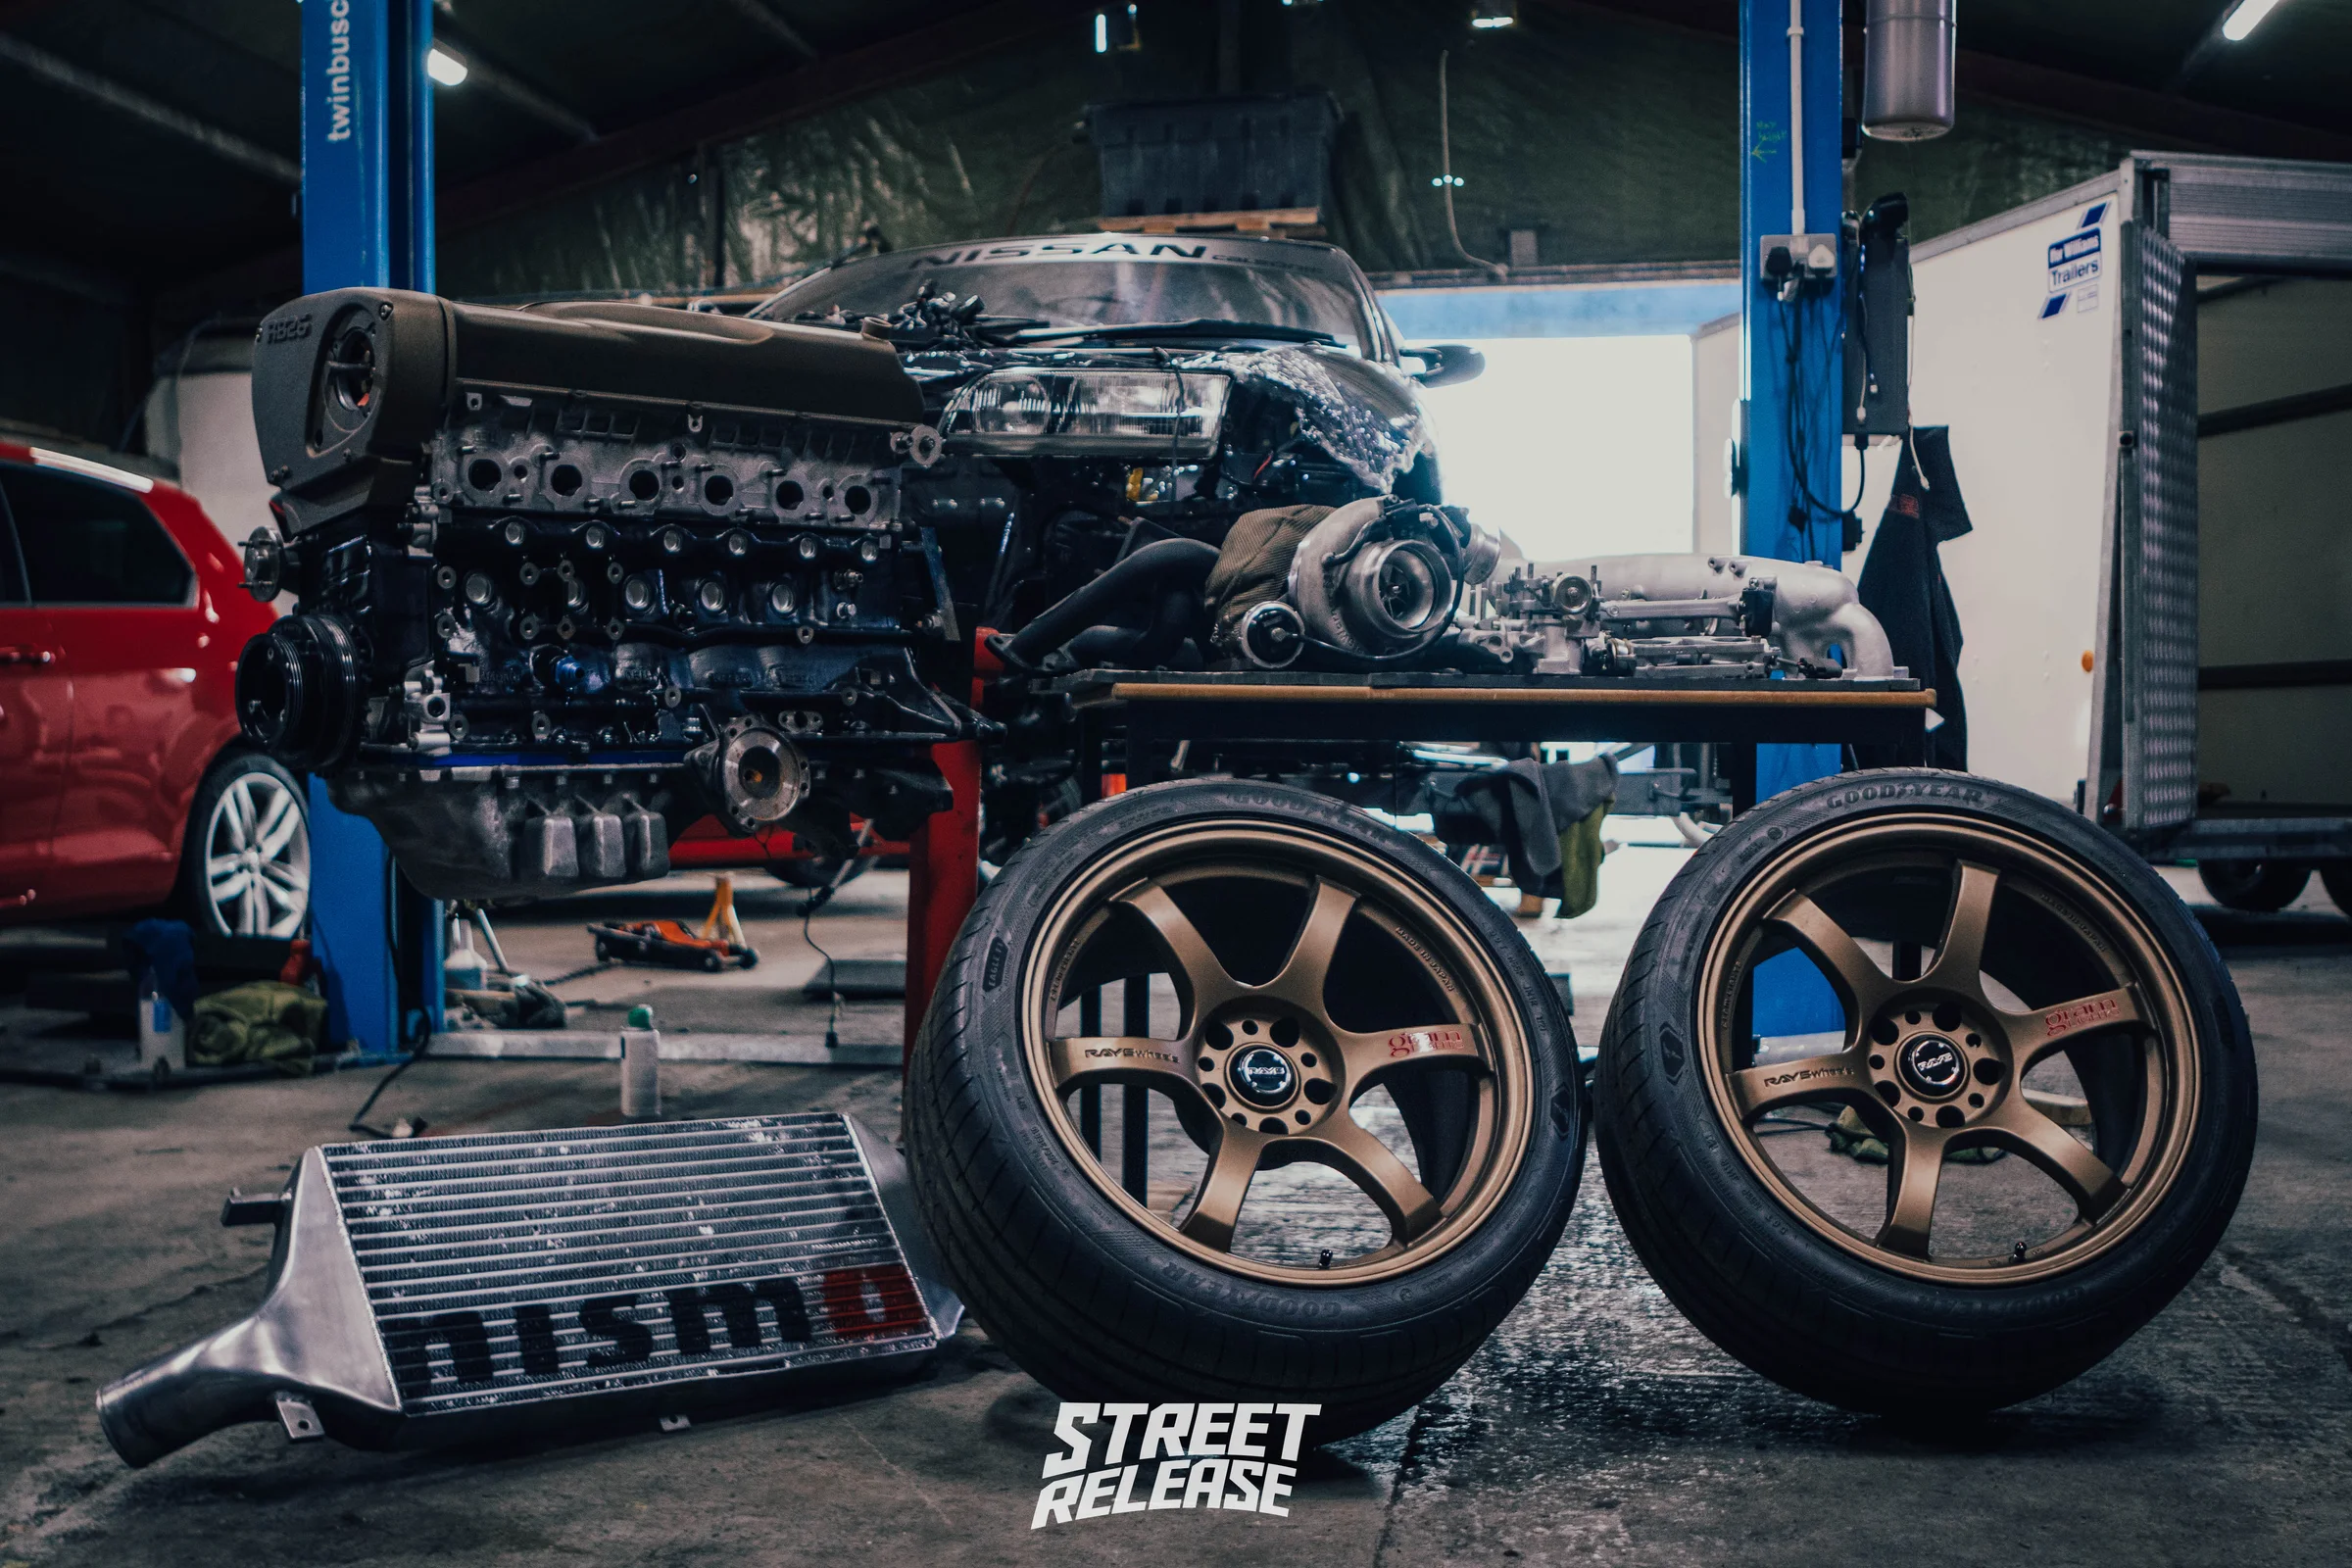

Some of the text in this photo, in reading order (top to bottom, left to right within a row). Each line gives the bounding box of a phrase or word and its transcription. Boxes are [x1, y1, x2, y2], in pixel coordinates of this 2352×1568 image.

[908, 241, 1207, 270] NISSAN
[2052, 260, 2099, 285] Trailers
[1827, 784, 1985, 809] GOODYEAR
[988, 955, 1001, 987] EAGLE
[1396, 926, 1421, 952] MADE
[1430, 961, 1454, 992] JAPAN
[2045, 999, 2117, 1036] gram
[1388, 1031, 1461, 1058] grm
[1247, 1066, 1286, 1075] RAYS
[1917, 1052, 1953, 1072] RAYS
[384, 1262, 931, 1397] nismo
